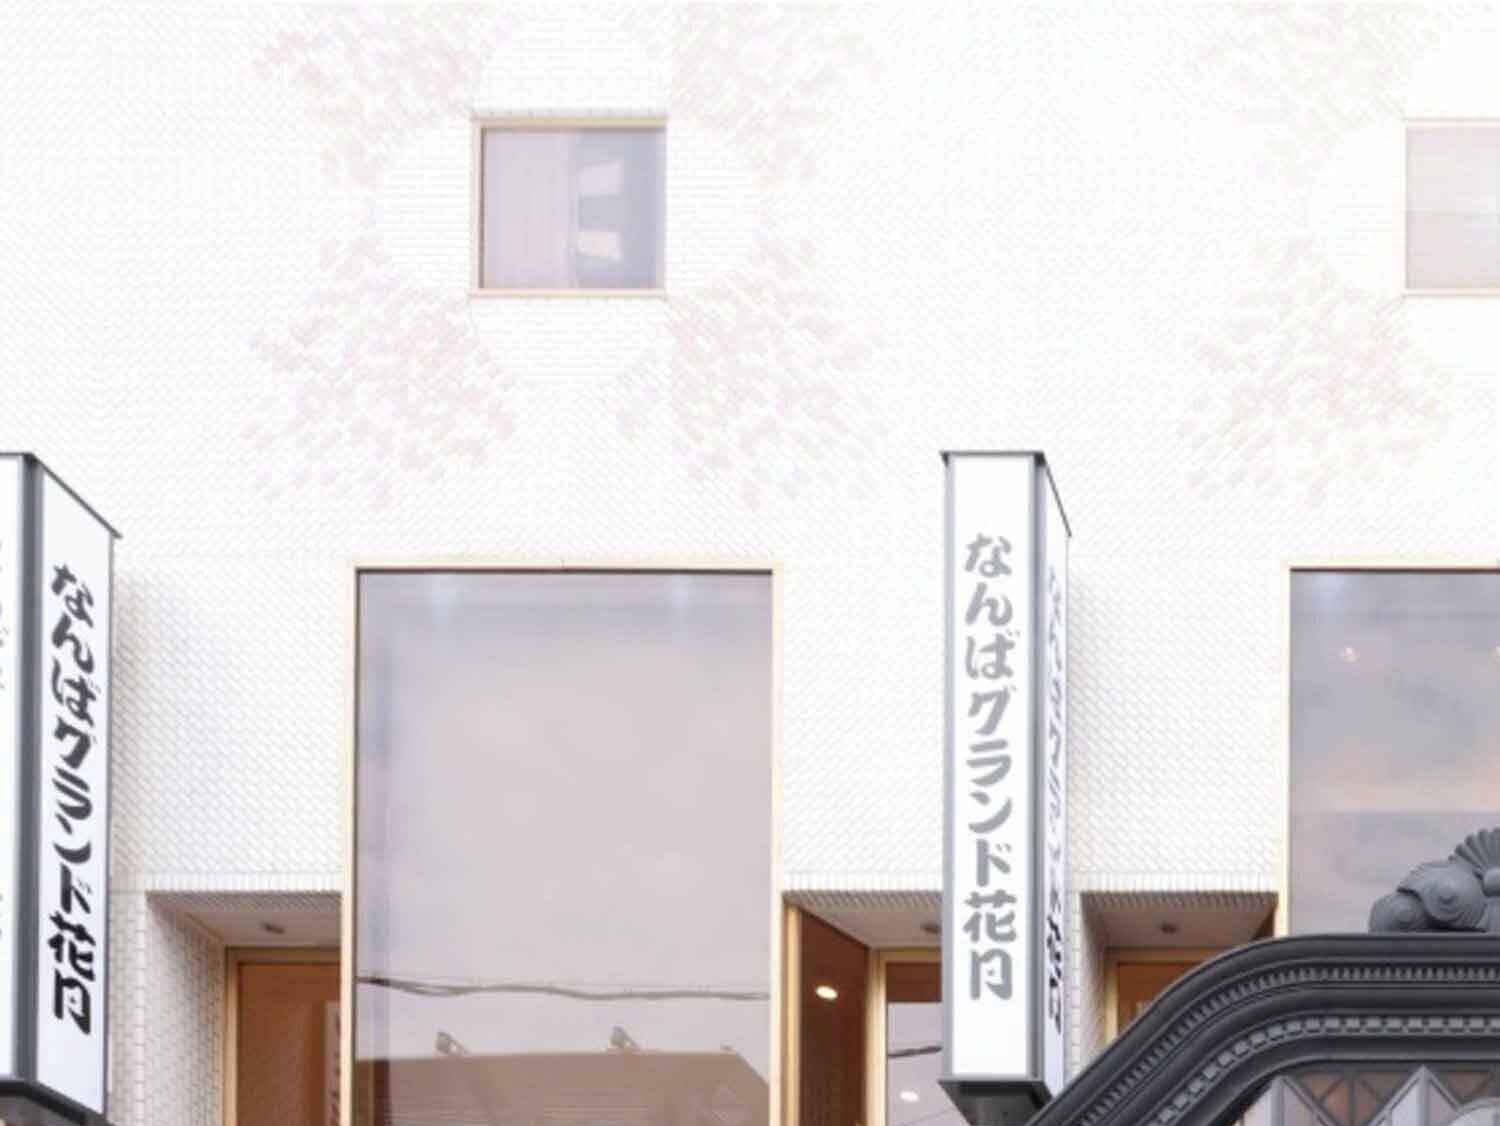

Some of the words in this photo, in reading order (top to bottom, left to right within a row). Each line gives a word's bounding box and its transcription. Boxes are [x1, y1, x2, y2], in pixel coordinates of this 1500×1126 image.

[48, 562, 97, 1036] なんばグランド花月
[962, 533, 1020, 1001] なんばグランド花月
